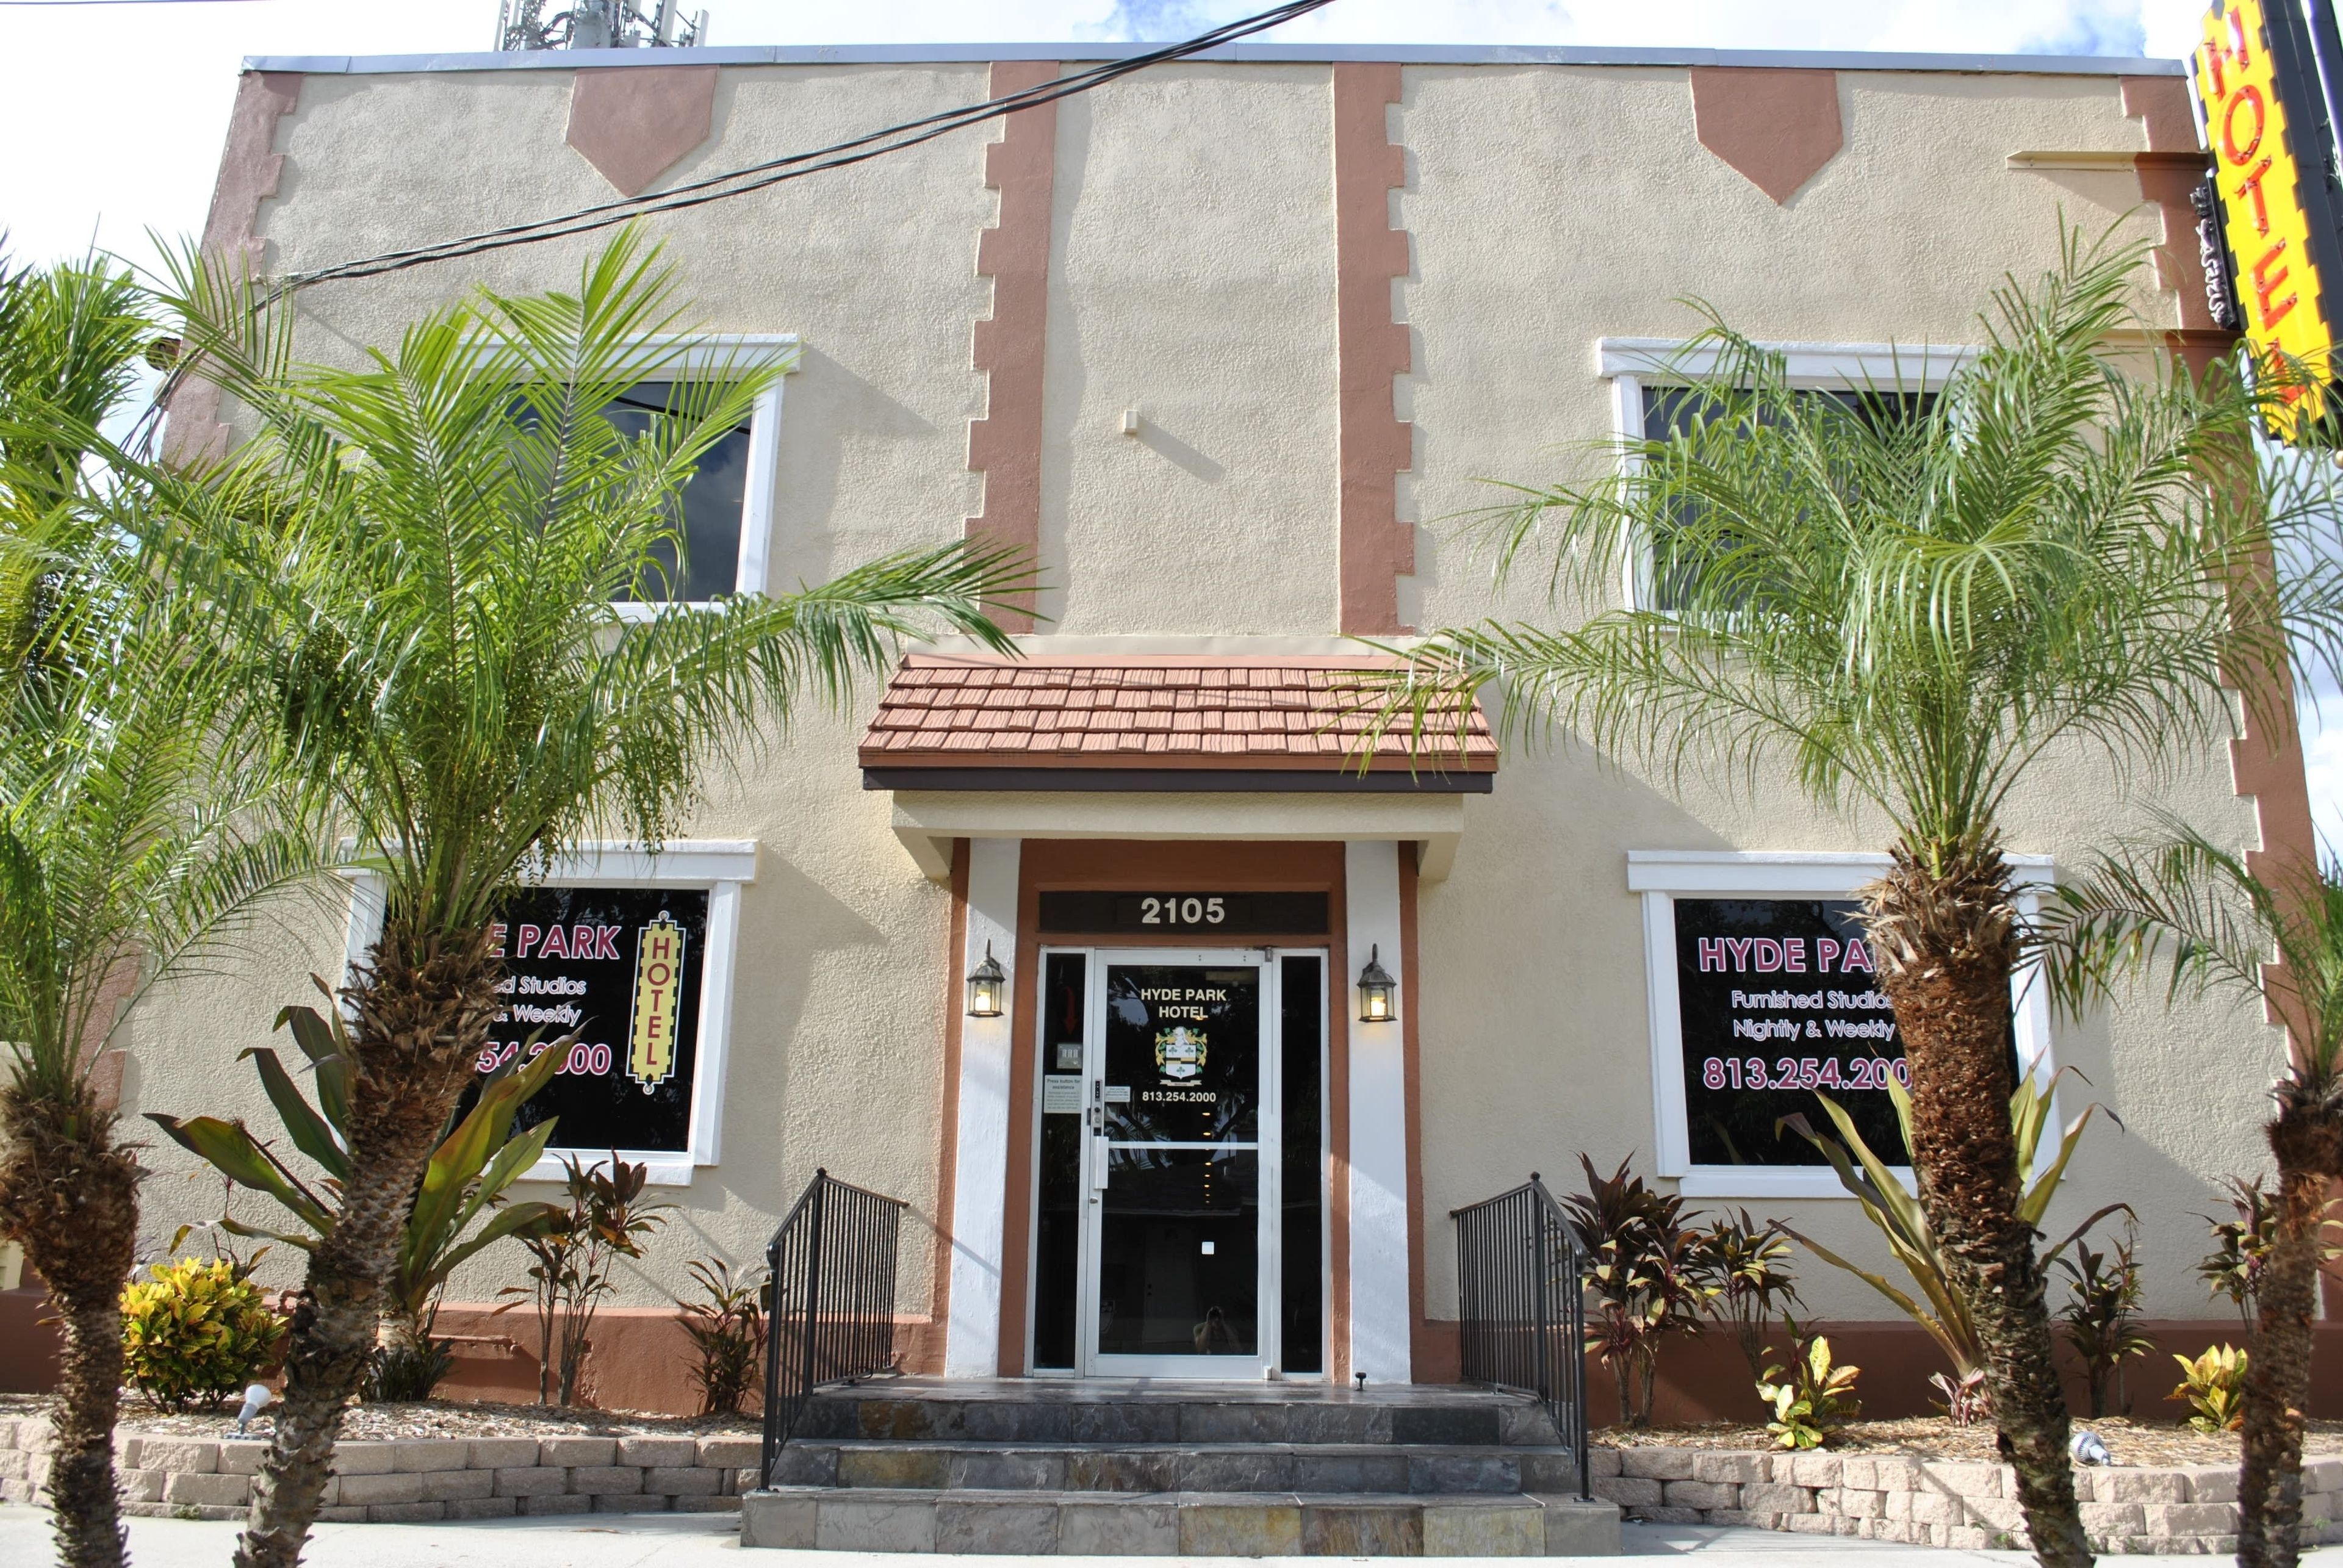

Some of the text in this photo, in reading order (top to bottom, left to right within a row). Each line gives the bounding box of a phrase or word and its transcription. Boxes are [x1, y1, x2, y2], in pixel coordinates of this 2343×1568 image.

[2202, 5, 2310, 405] HOTEL
[1141, 897, 1225, 924] 2105
[517, 924, 622, 959] PARK
[1699, 937, 1877, 972] HYDE PA
[519, 976, 586, 994] Studios
[1141, 988, 1226, 1001] HYDE PARK
[646, 937, 670, 1065] HOTEL
[1732, 990, 1823, 1009] Furnished
[513, 1004, 581, 1027] Weekly
[1159, 1006, 1208, 1018] HOTEL
[1733, 1019, 1895, 1041] Nightly & Weekly
[1704, 1057, 1912, 1090] 813.254.200
[1142, 1091, 1217, 1102] 813.254.2000
